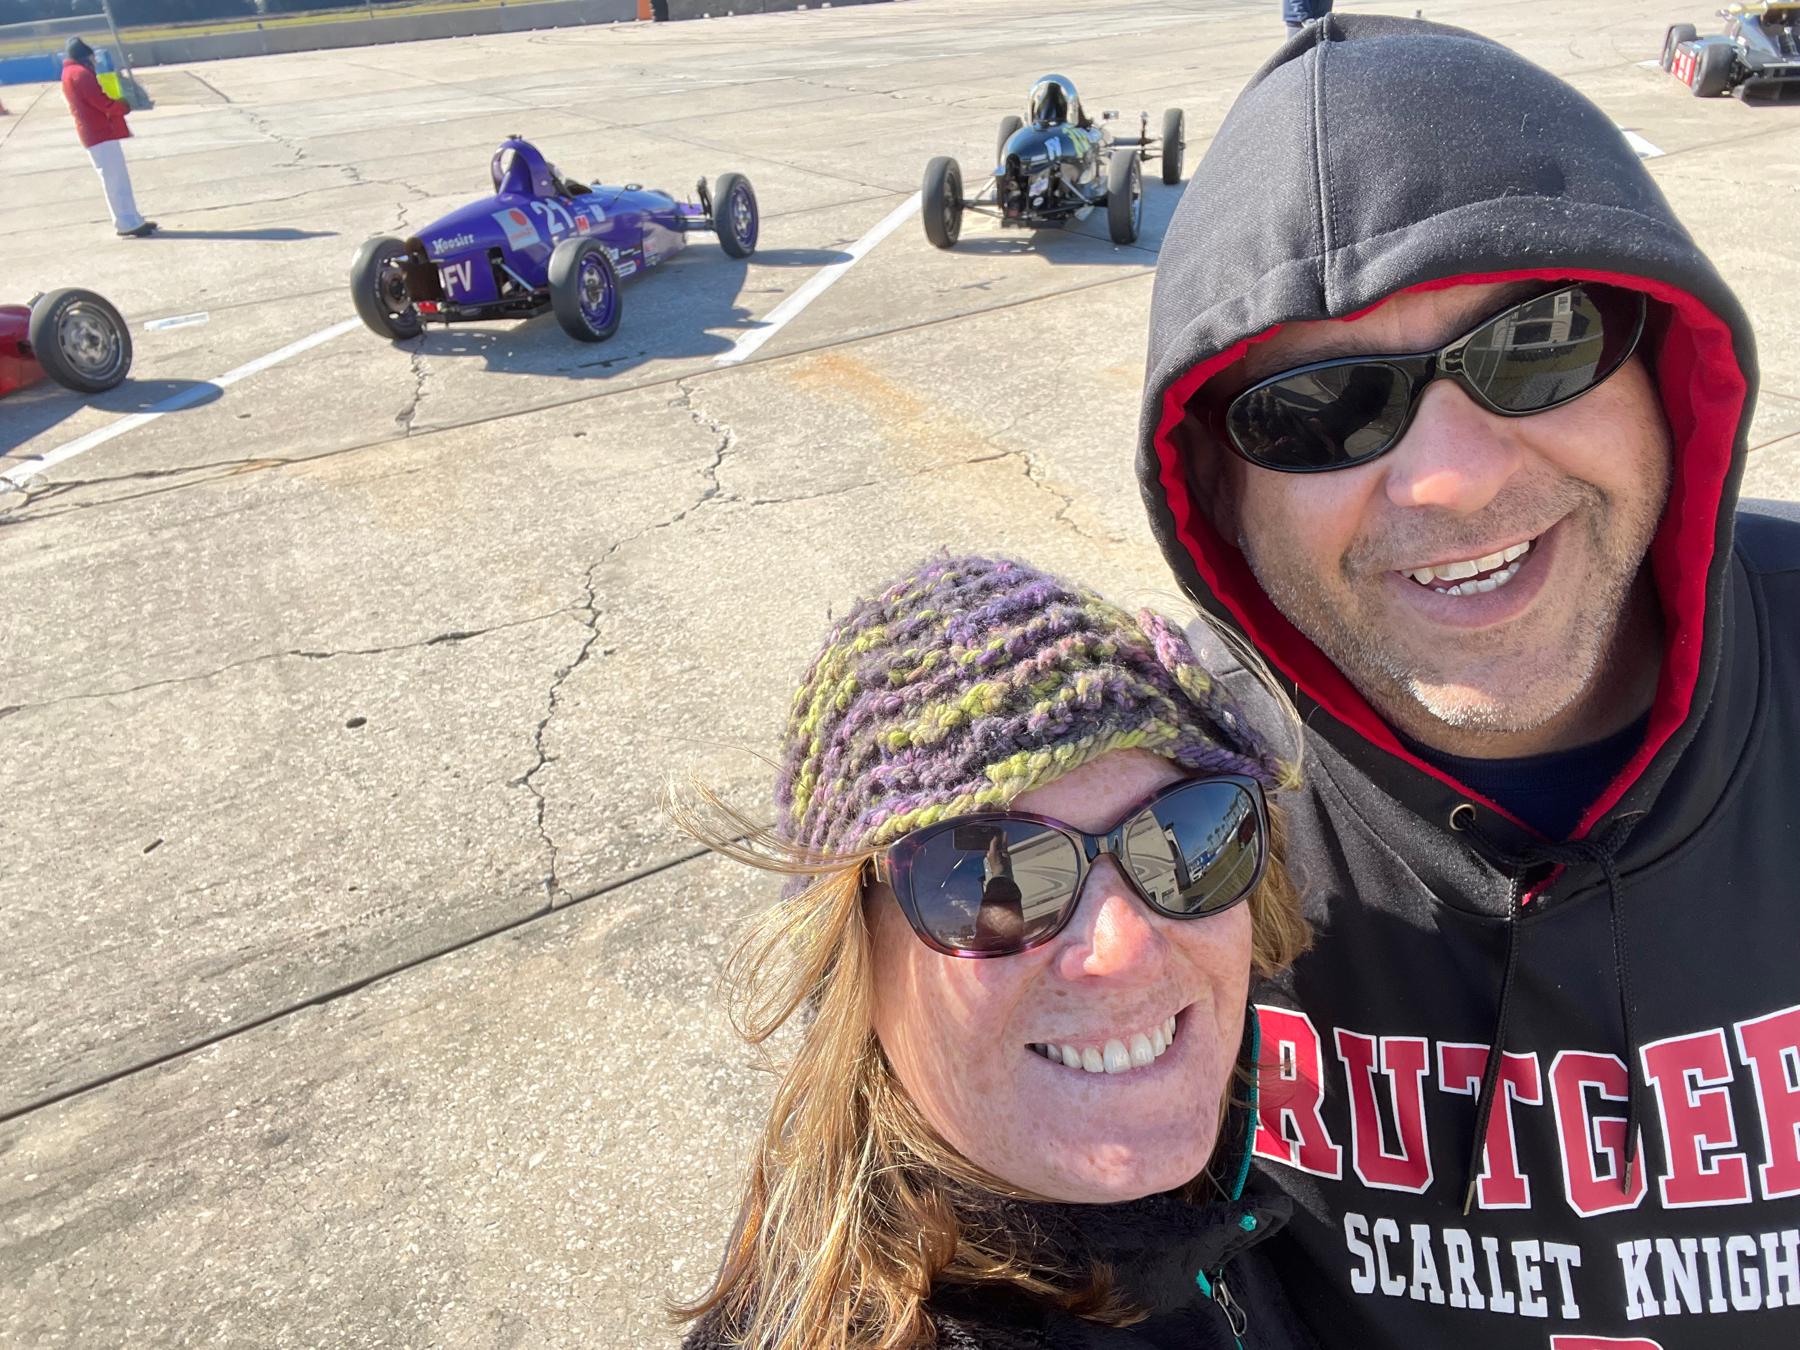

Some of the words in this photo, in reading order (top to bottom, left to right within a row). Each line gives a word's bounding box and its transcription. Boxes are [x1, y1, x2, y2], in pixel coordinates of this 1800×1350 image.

[432, 233, 474, 255] Hoosier
[1251, 1003, 1800, 1217] RUTGER
[1344, 1212, 1581, 1319] SCARLET
[1617, 1229, 1800, 1320] KNIGH
